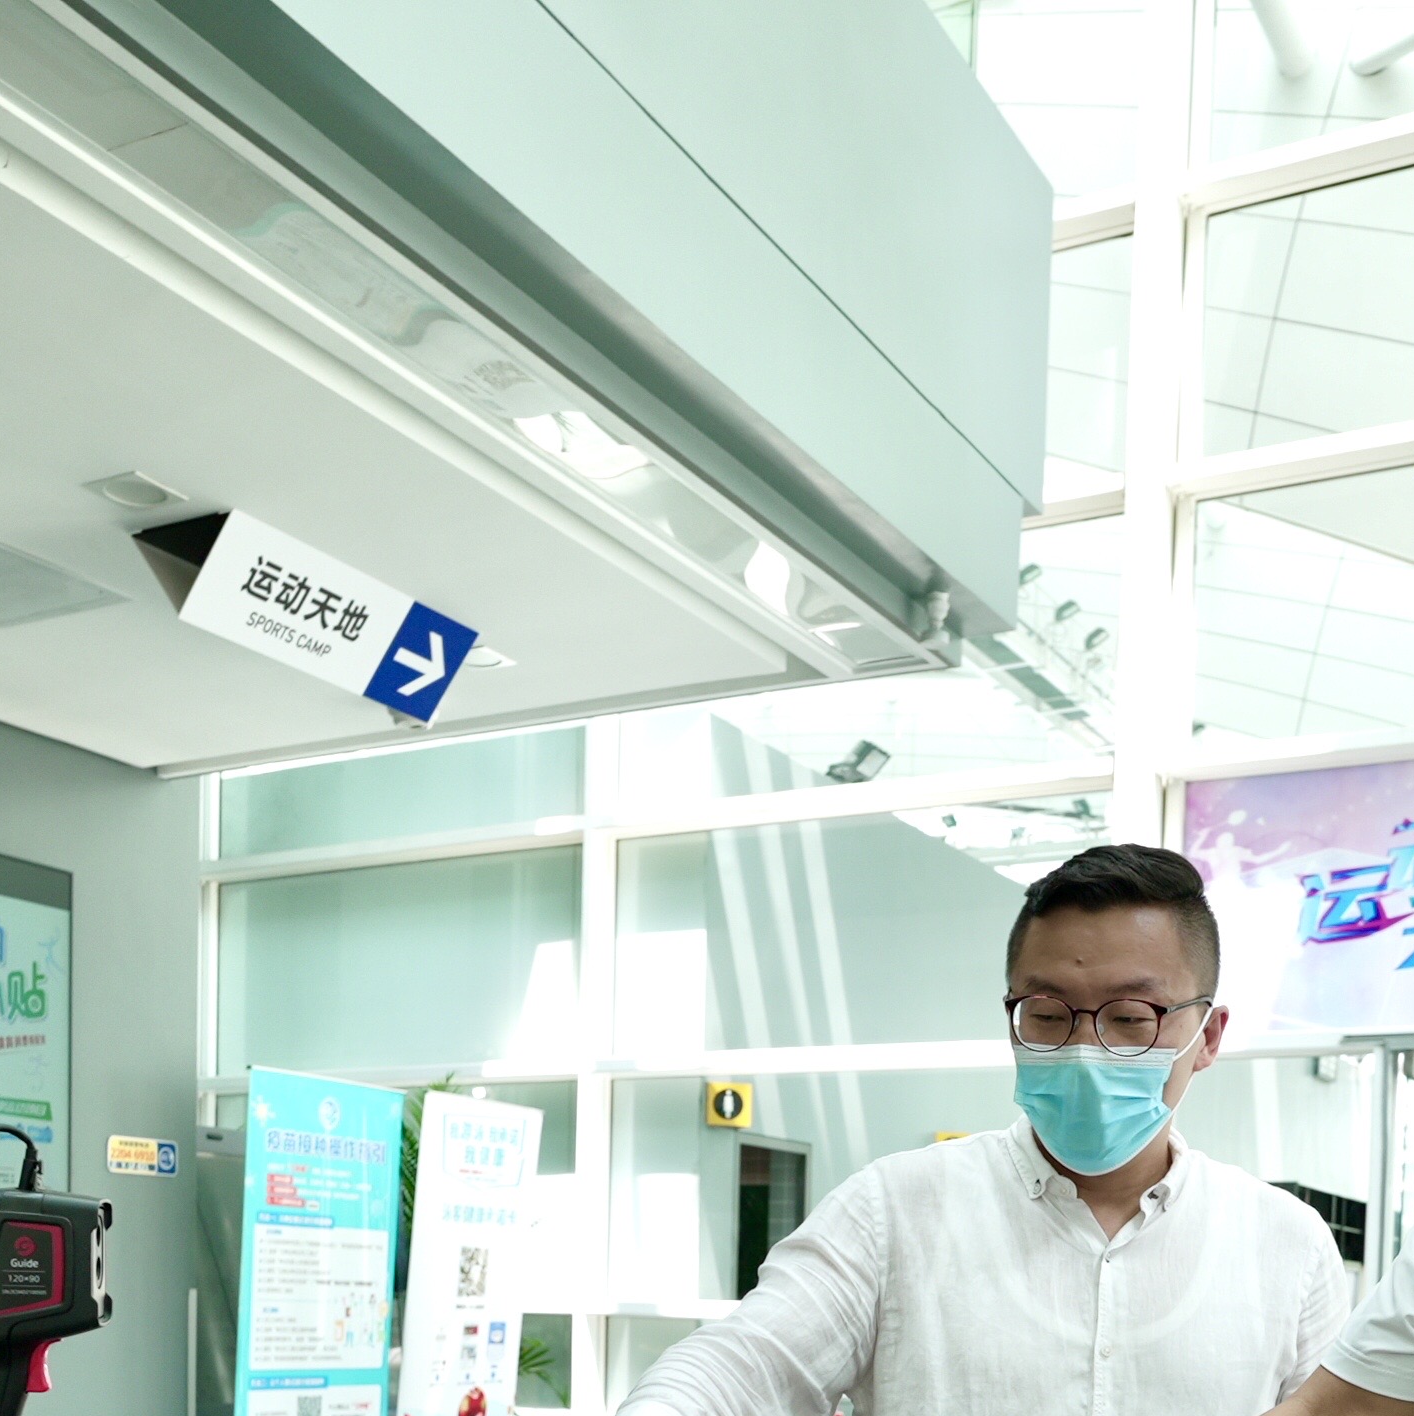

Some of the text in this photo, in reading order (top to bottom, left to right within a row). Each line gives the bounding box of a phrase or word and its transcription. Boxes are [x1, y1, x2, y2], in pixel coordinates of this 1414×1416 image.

[241, 555, 369, 642] 运动天地
[246, 611, 332, 658] SPORTS CAMP
[10, 1258, 40, 1269] Guide
